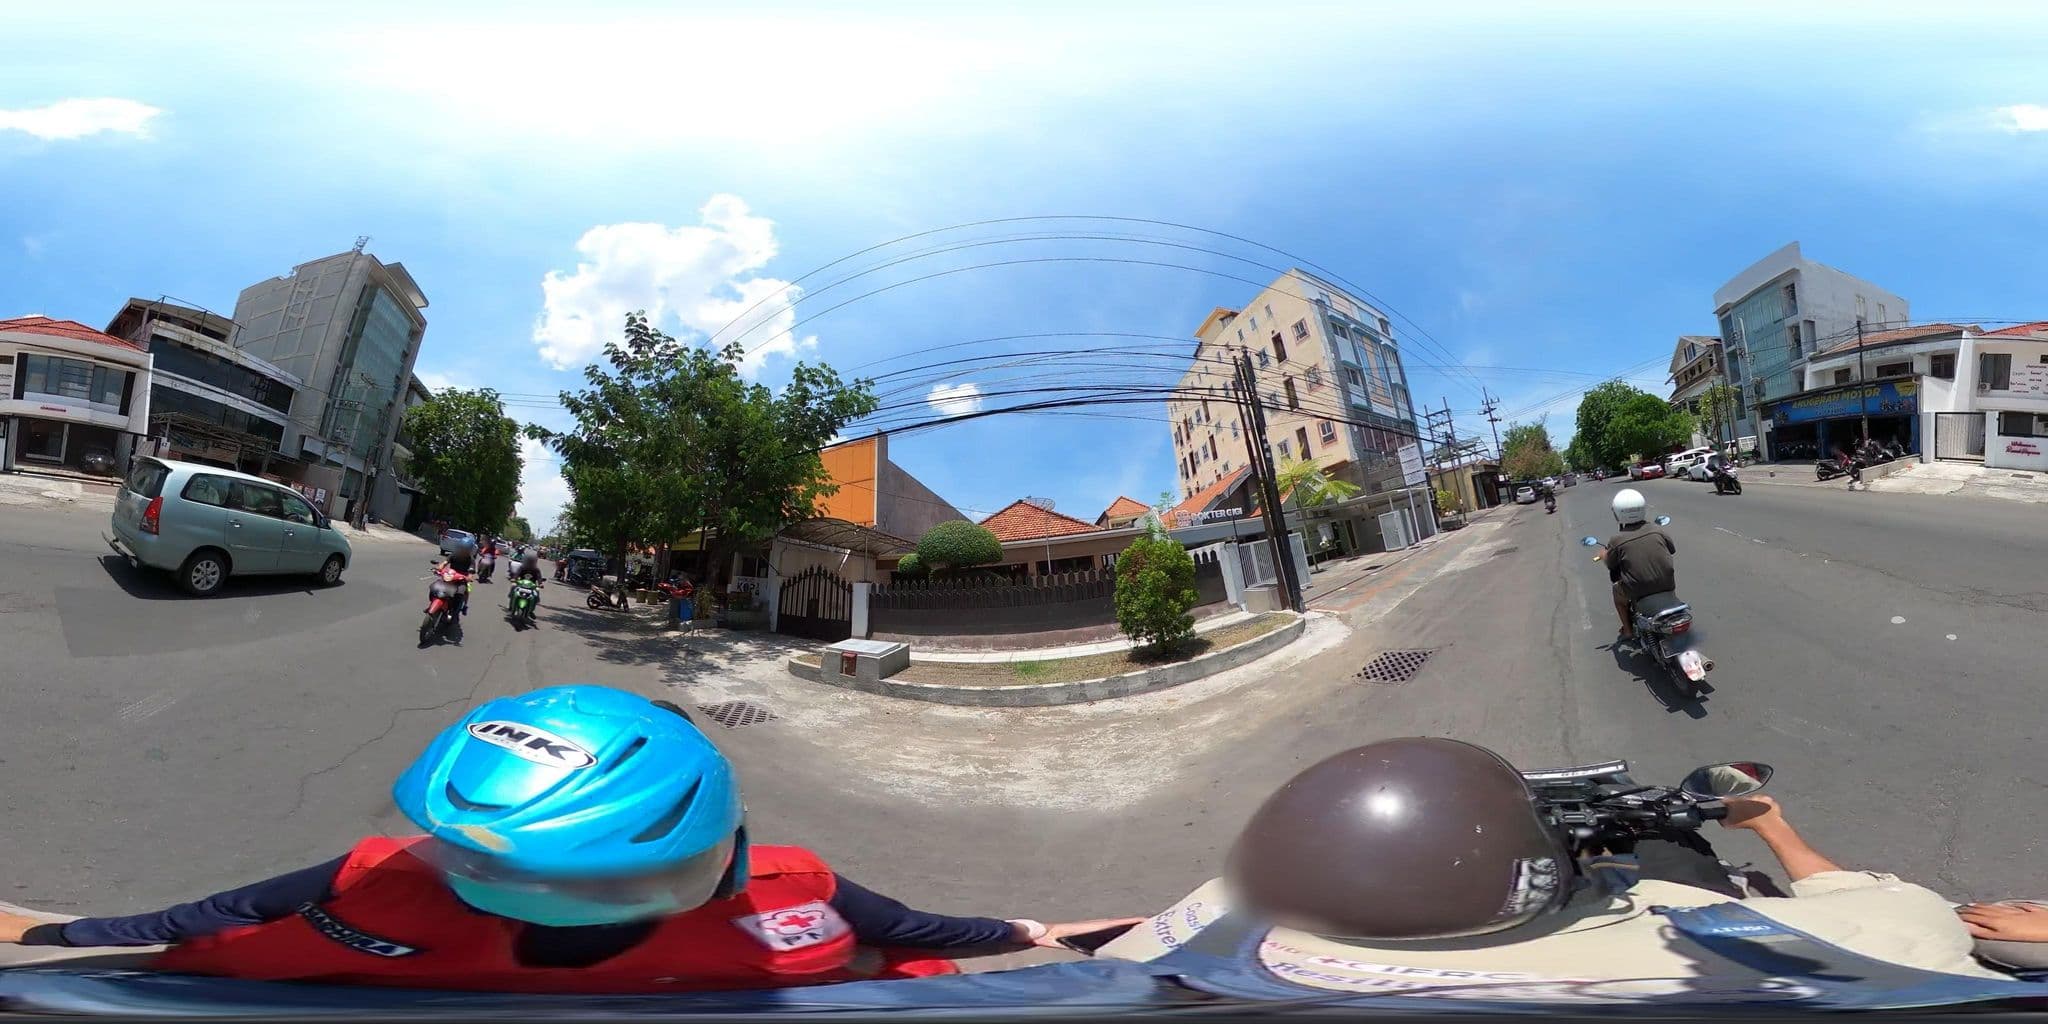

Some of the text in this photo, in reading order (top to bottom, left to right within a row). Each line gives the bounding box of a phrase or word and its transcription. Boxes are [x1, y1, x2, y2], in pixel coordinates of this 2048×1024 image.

[1841, 387, 1881, 401] MOTOR
[478, 724, 581, 761] INK
[1383, 966, 1531, 980] IFRC
